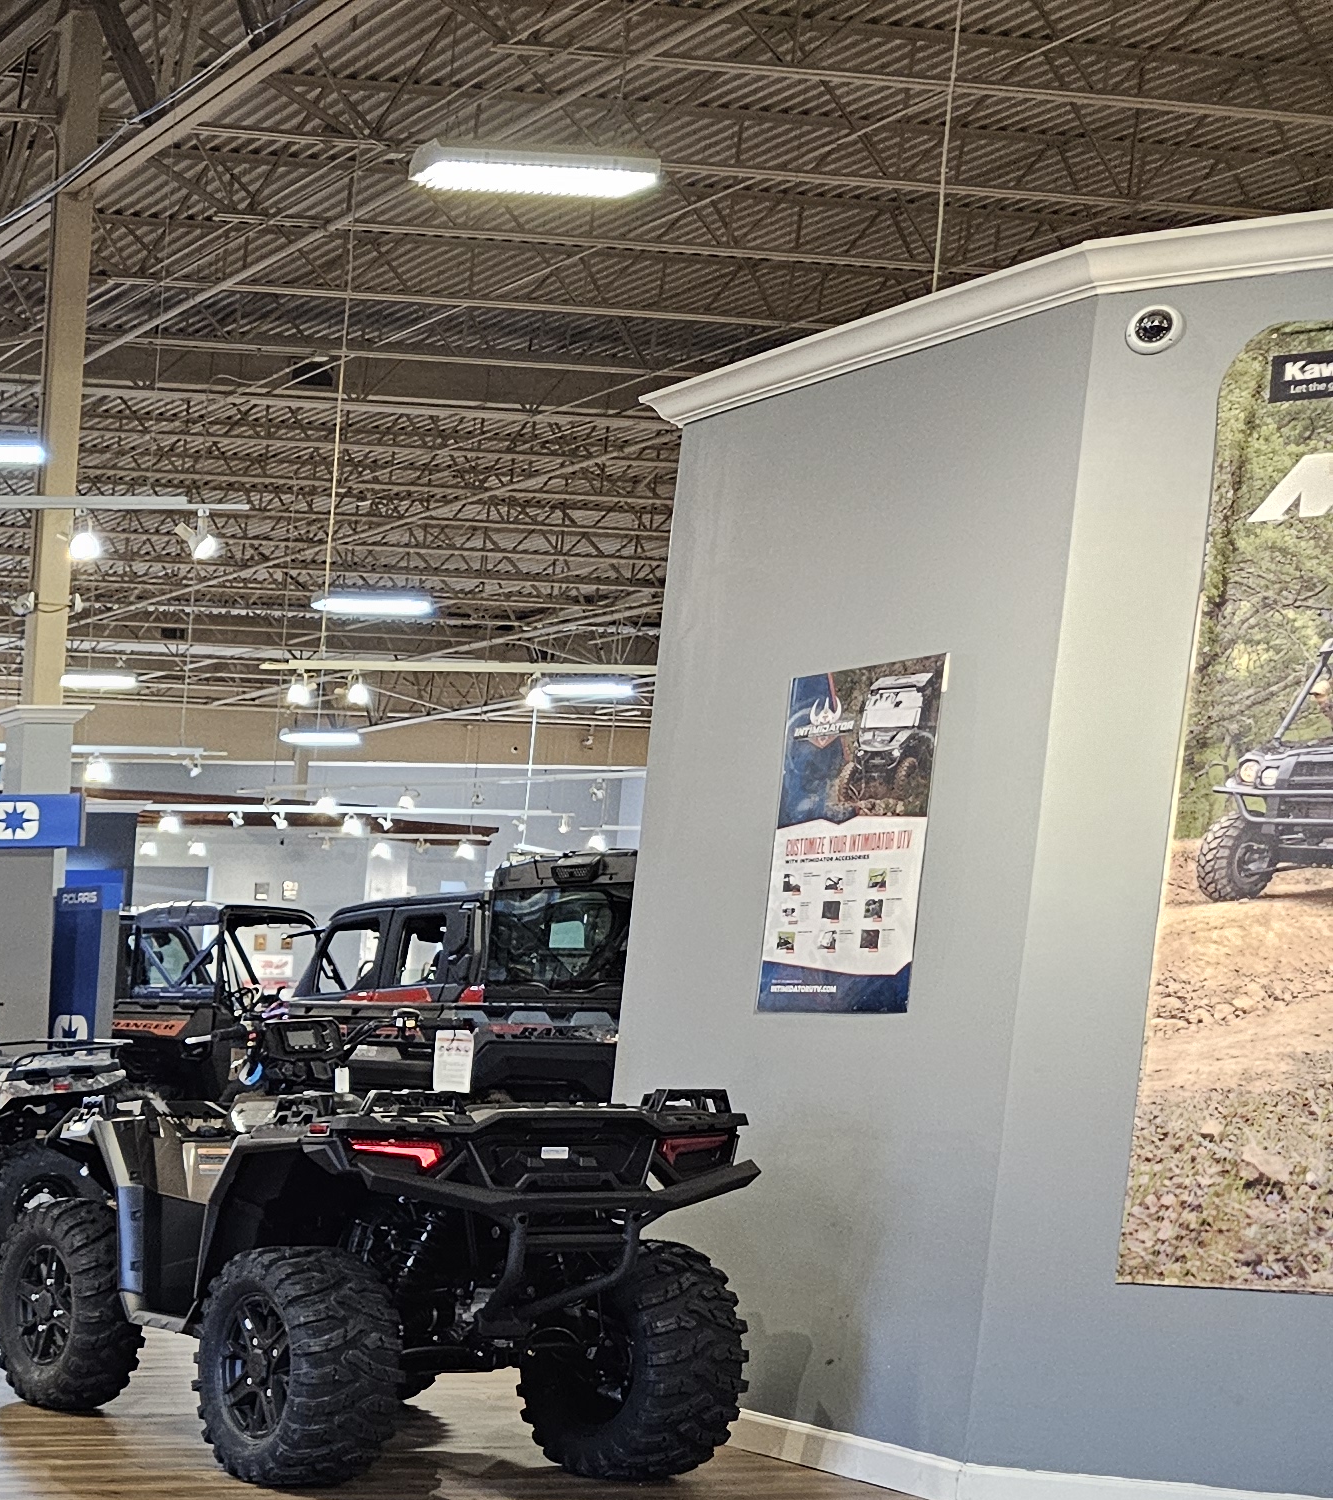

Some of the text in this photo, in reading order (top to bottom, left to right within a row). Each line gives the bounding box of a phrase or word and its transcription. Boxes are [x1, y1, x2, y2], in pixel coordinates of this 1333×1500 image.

[1290, 384, 1307, 394] Let
[1308, 382, 1327, 392] the
[794, 720, 855, 737] INTIMIDATOR
[786, 829, 913, 856] CUSTOMIZE YOUR INTIMIDATOR UTV
[799, 856, 834, 864] INTIMIDATOR
[834, 854, 870, 862] ACCESSORIES
[62, 891, 98, 905] POLARIS
